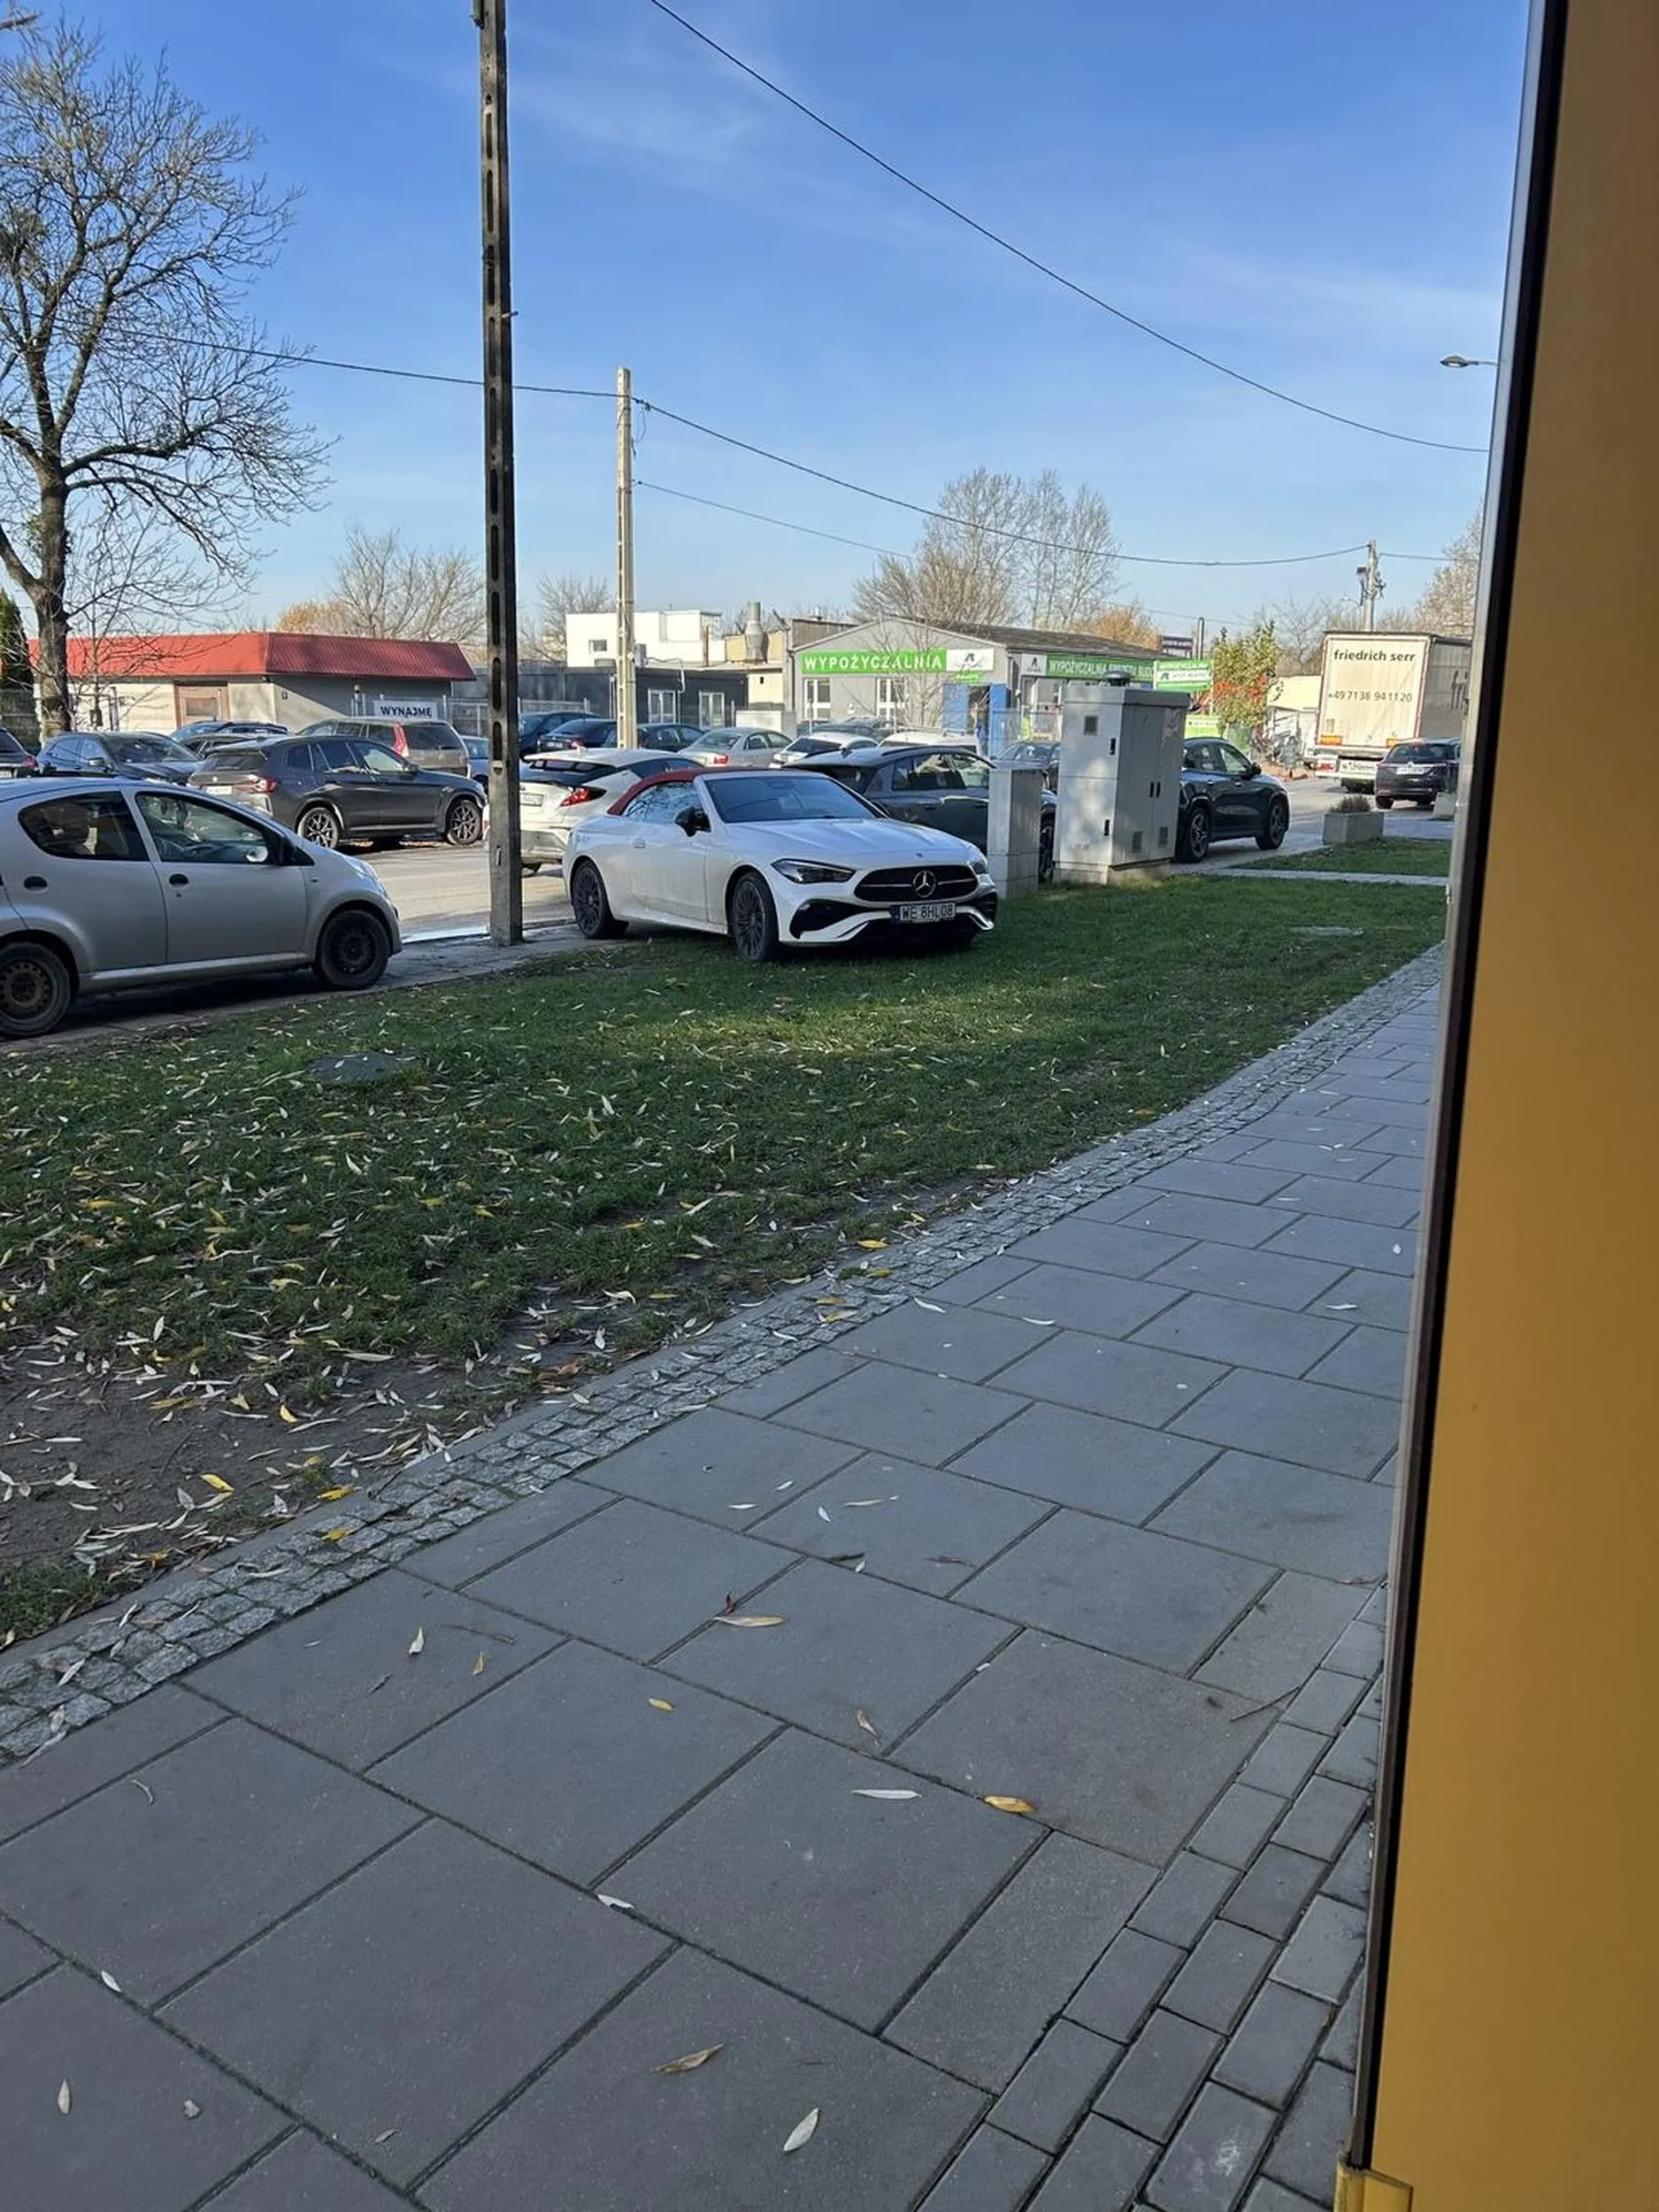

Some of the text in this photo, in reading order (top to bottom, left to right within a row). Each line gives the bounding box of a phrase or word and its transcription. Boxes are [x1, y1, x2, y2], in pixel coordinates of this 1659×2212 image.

[804, 654, 942, 670] WYPOŻYCZALNIA
[1333, 649, 1417, 663] friedrich serr
[902, 903, 954, 919] WE 8HL08
